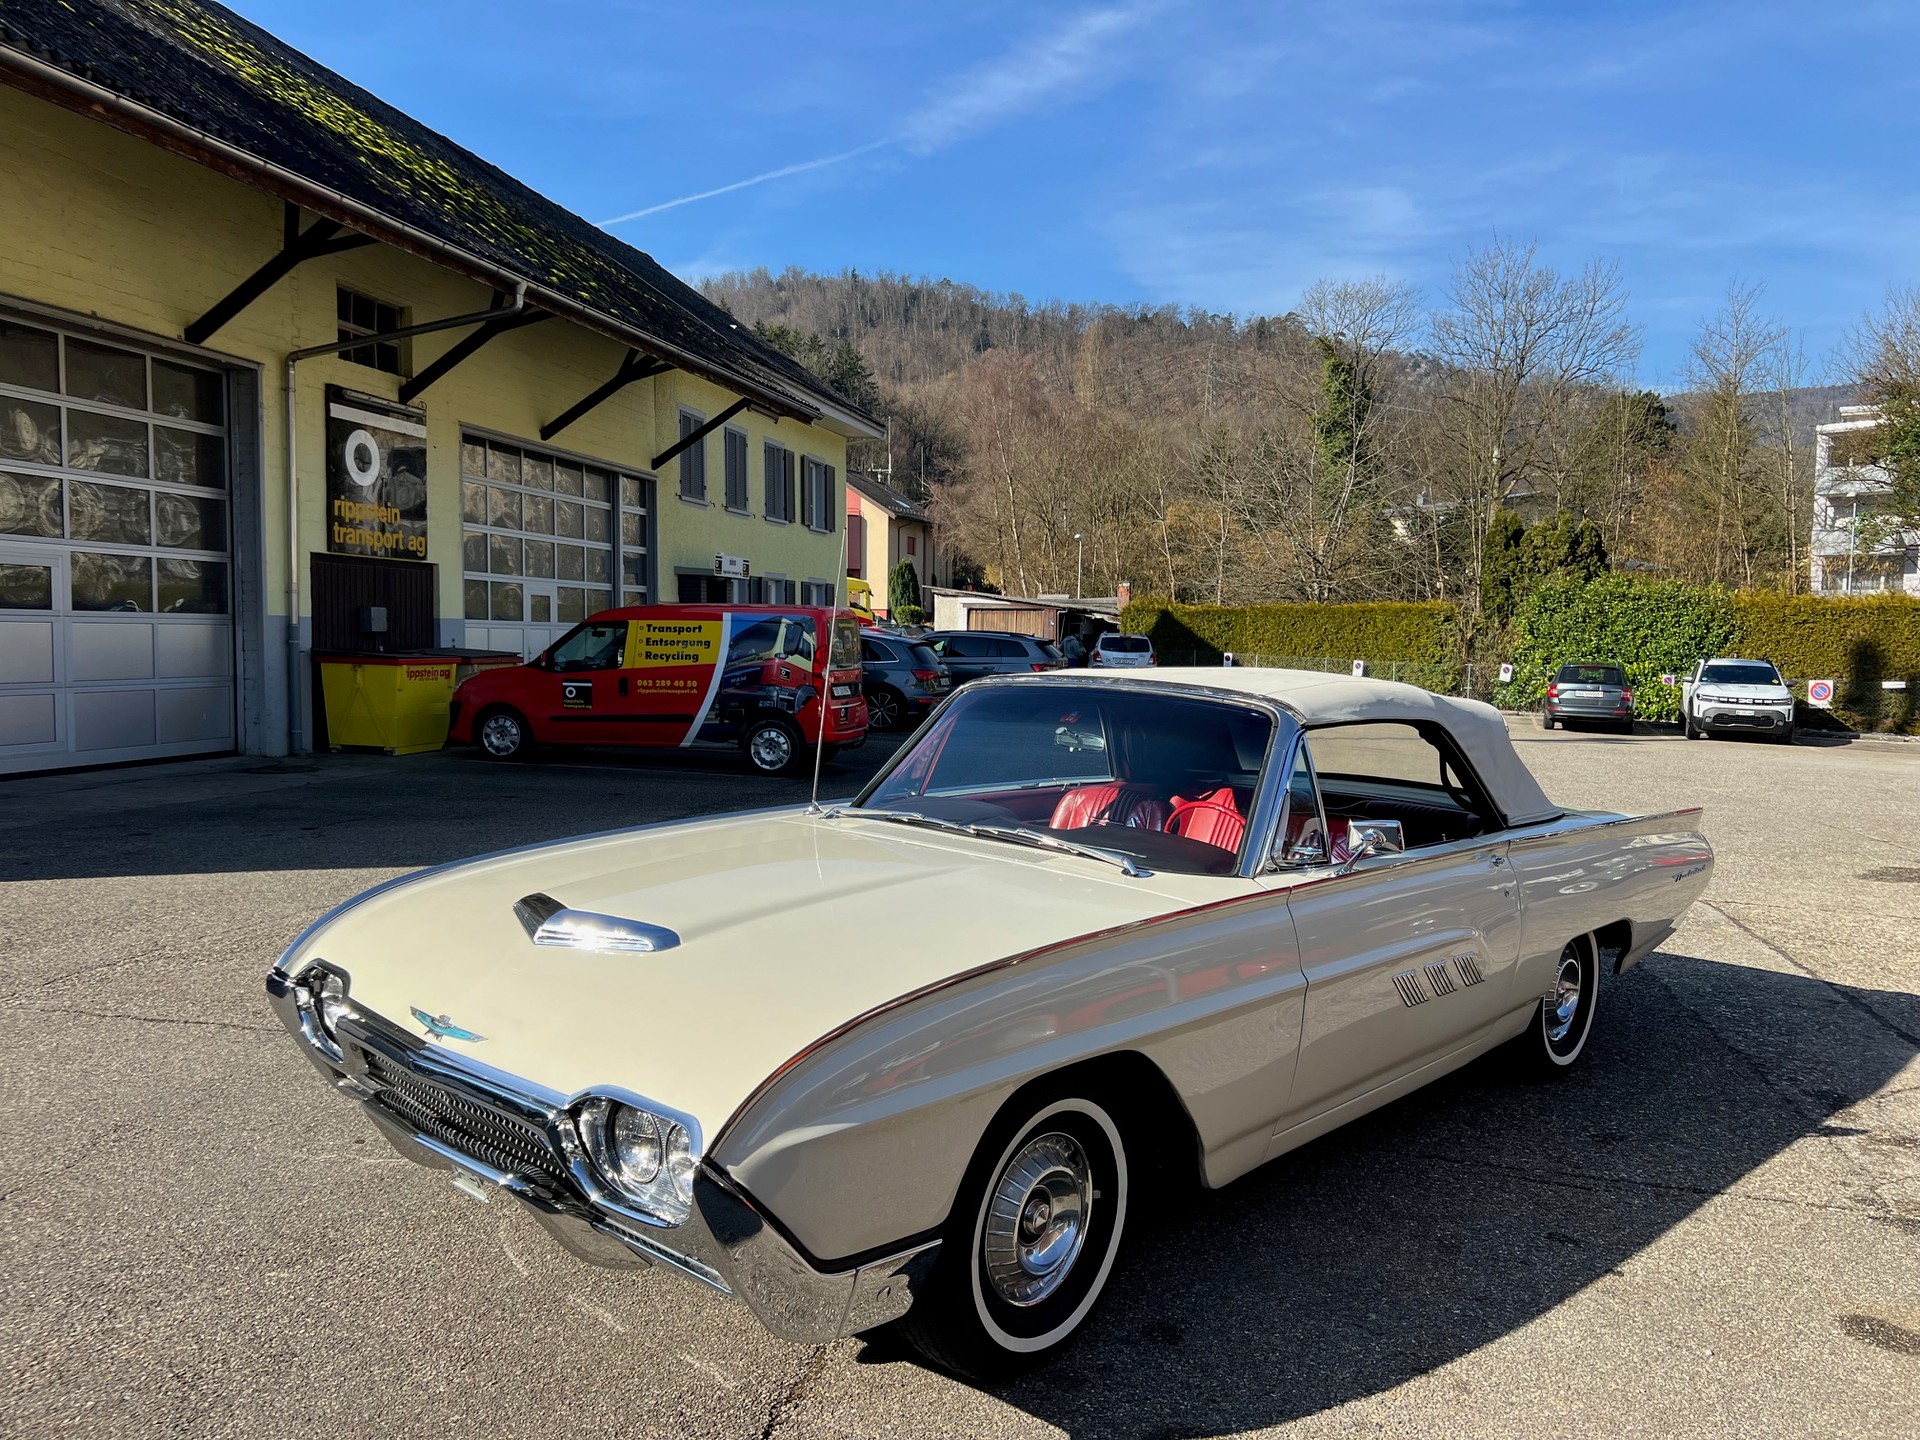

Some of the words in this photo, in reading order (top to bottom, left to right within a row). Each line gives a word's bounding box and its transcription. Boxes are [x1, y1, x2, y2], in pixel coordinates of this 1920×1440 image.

[334, 495, 400, 525] rippstein
[334, 525, 404, 551] transport
[408, 535, 426, 557] ag
[646, 624, 702, 635] Transport
[646, 638, 711, 649] Entsorgung
[645, 651, 699, 662] Recycling
[440, 669, 450, 679] ag
[637, 679, 653, 687] 062
[656, 679, 671, 687] 289
[687, 680, 698, 688] 50
